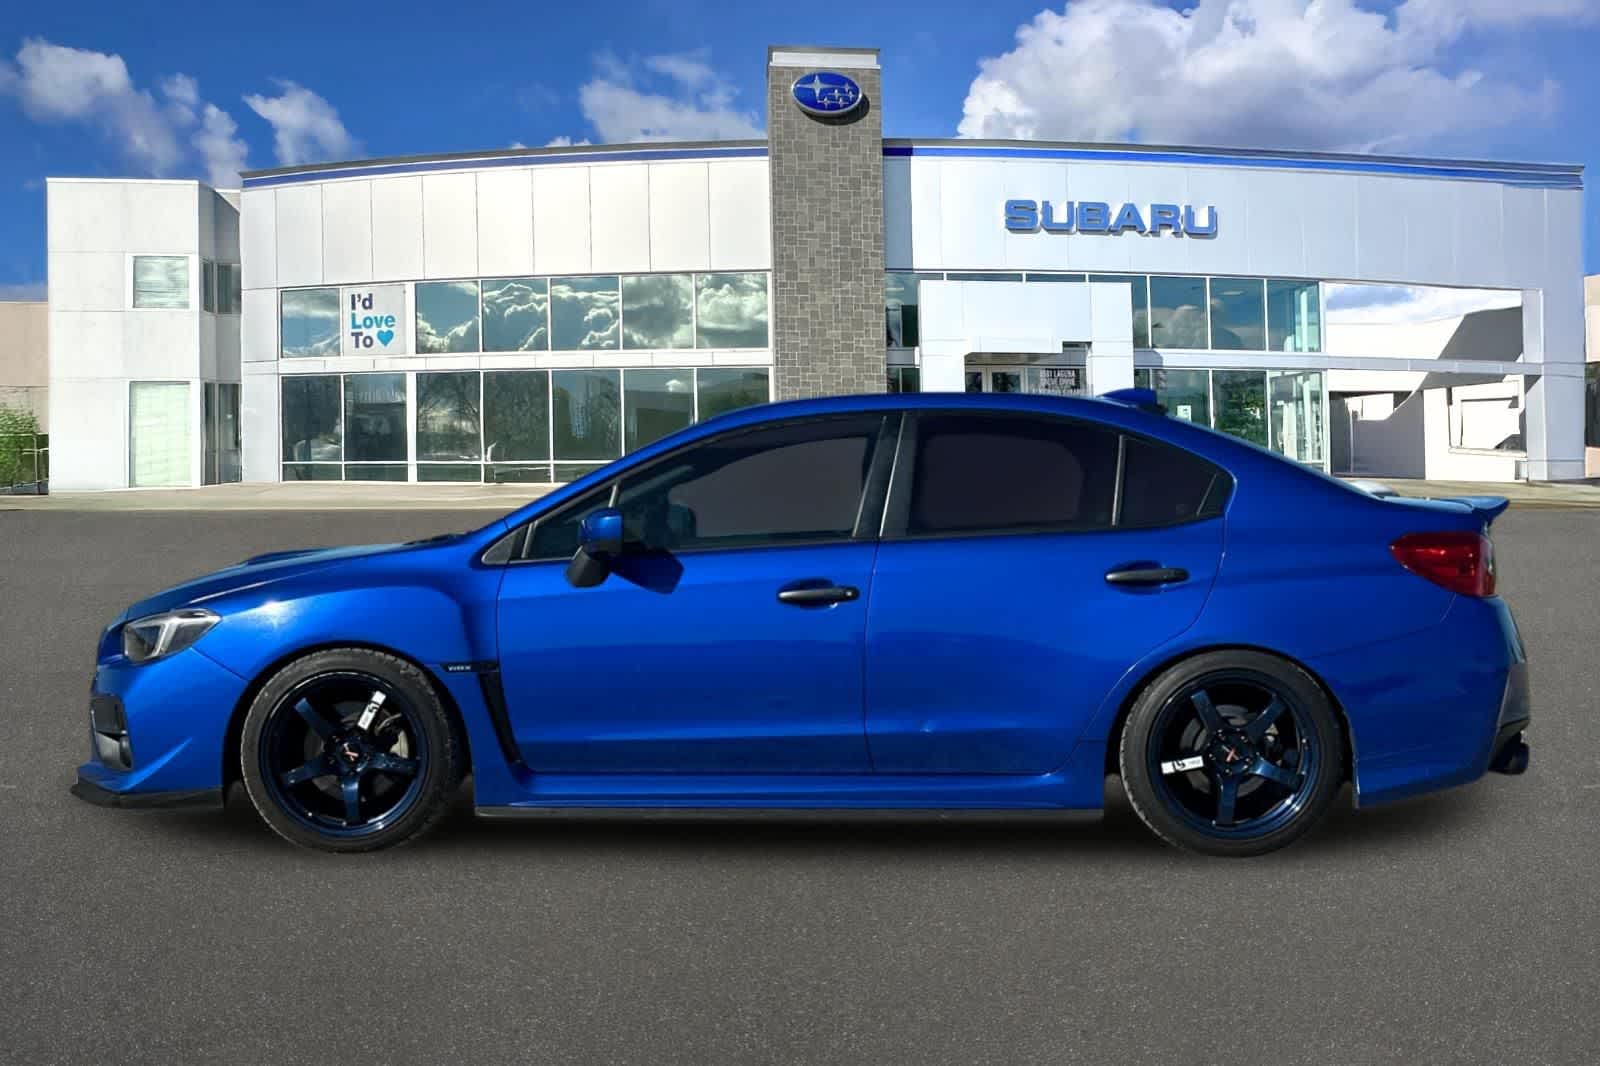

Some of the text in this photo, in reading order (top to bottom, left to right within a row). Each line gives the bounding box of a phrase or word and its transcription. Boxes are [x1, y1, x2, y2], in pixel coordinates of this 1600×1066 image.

[1005, 199, 1217, 237] SUBARU
[351, 293, 373, 310] I'd
[351, 312, 396, 329] Love
[351, 331, 373, 348] To
